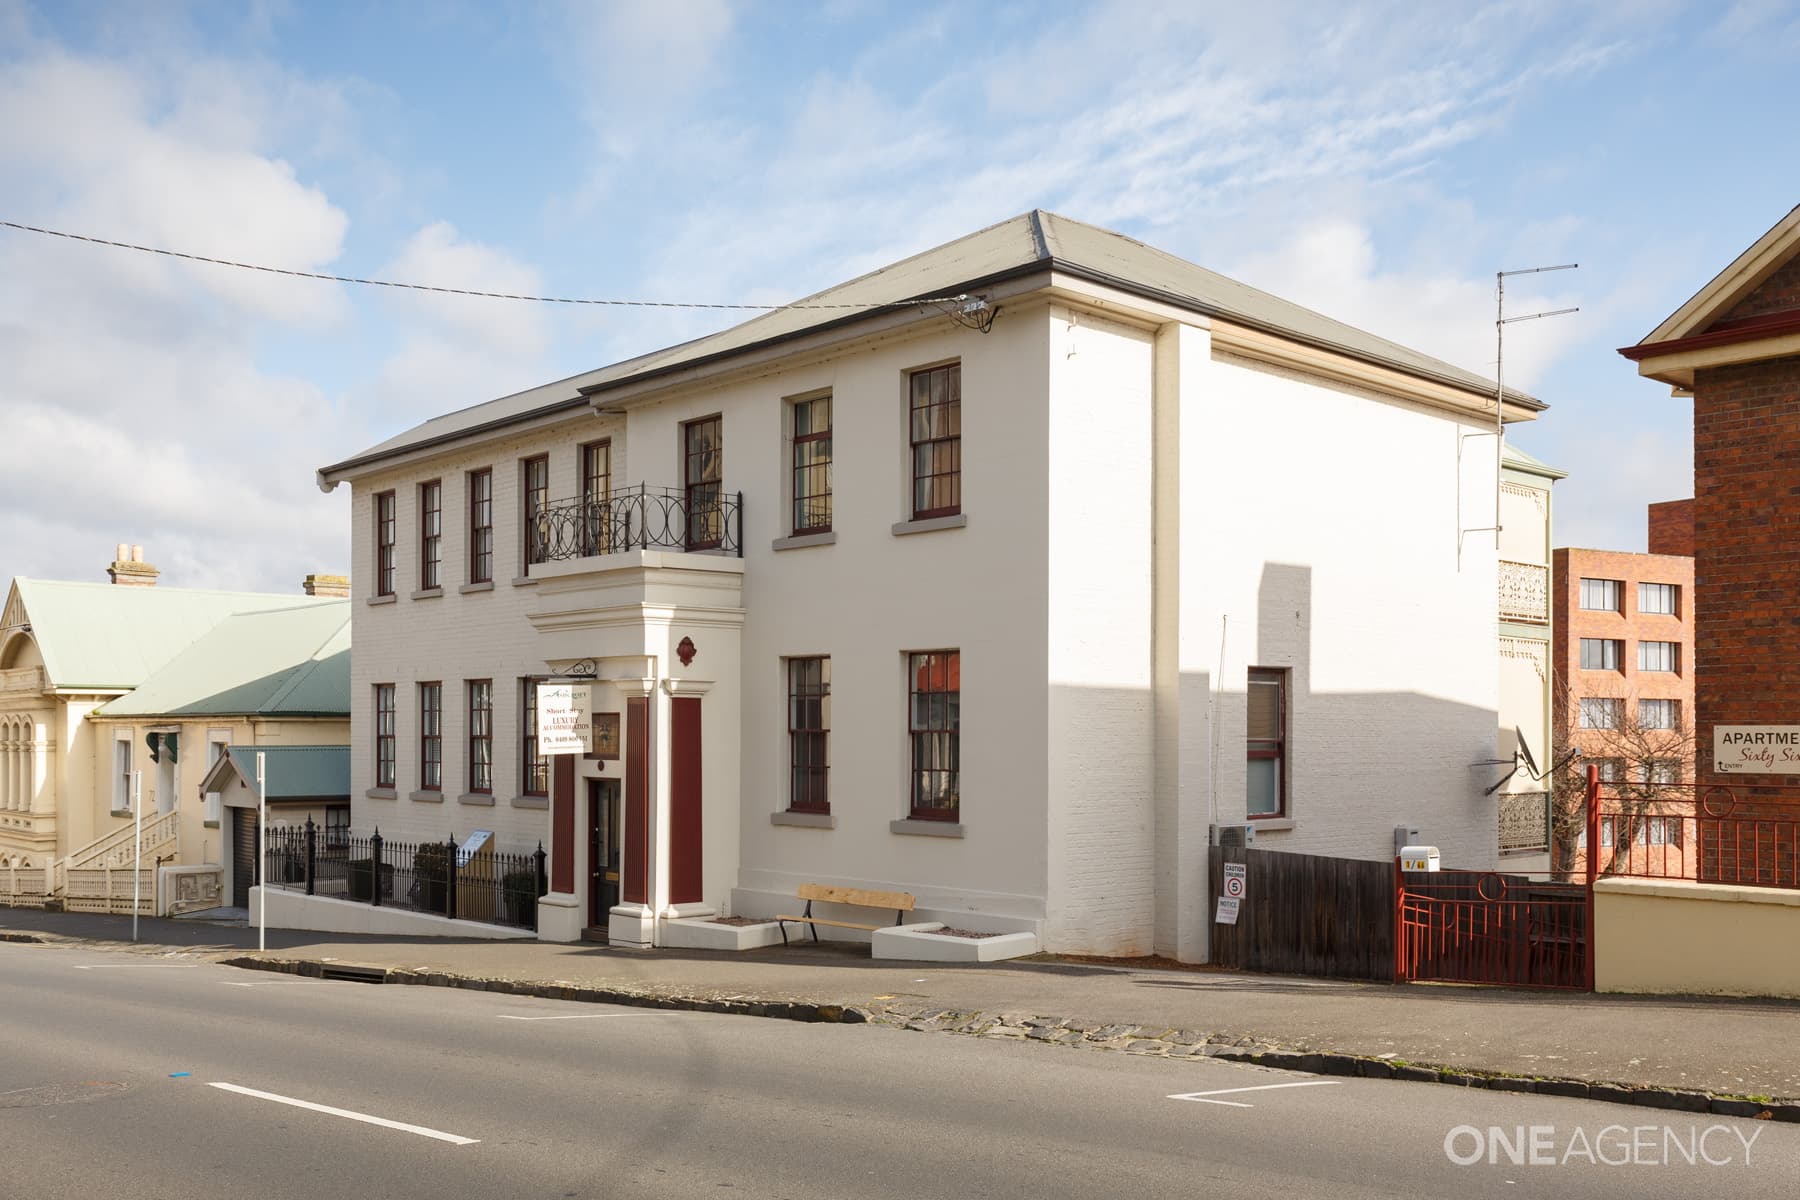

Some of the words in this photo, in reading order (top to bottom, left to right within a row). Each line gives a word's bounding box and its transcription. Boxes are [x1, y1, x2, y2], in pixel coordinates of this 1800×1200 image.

[569, 706, 584, 715] Stay
[552, 716, 579, 724] LUXURY
[543, 723, 589, 731] ACCOMMODATION
[1722, 732, 1799, 745] APARTME
[1739, 746, 1775, 768] Sixty
[1779, 746, 1800, 762] Six
[1225, 864, 1245, 873] CAUTION
[1232, 882, 1238, 892] 5
